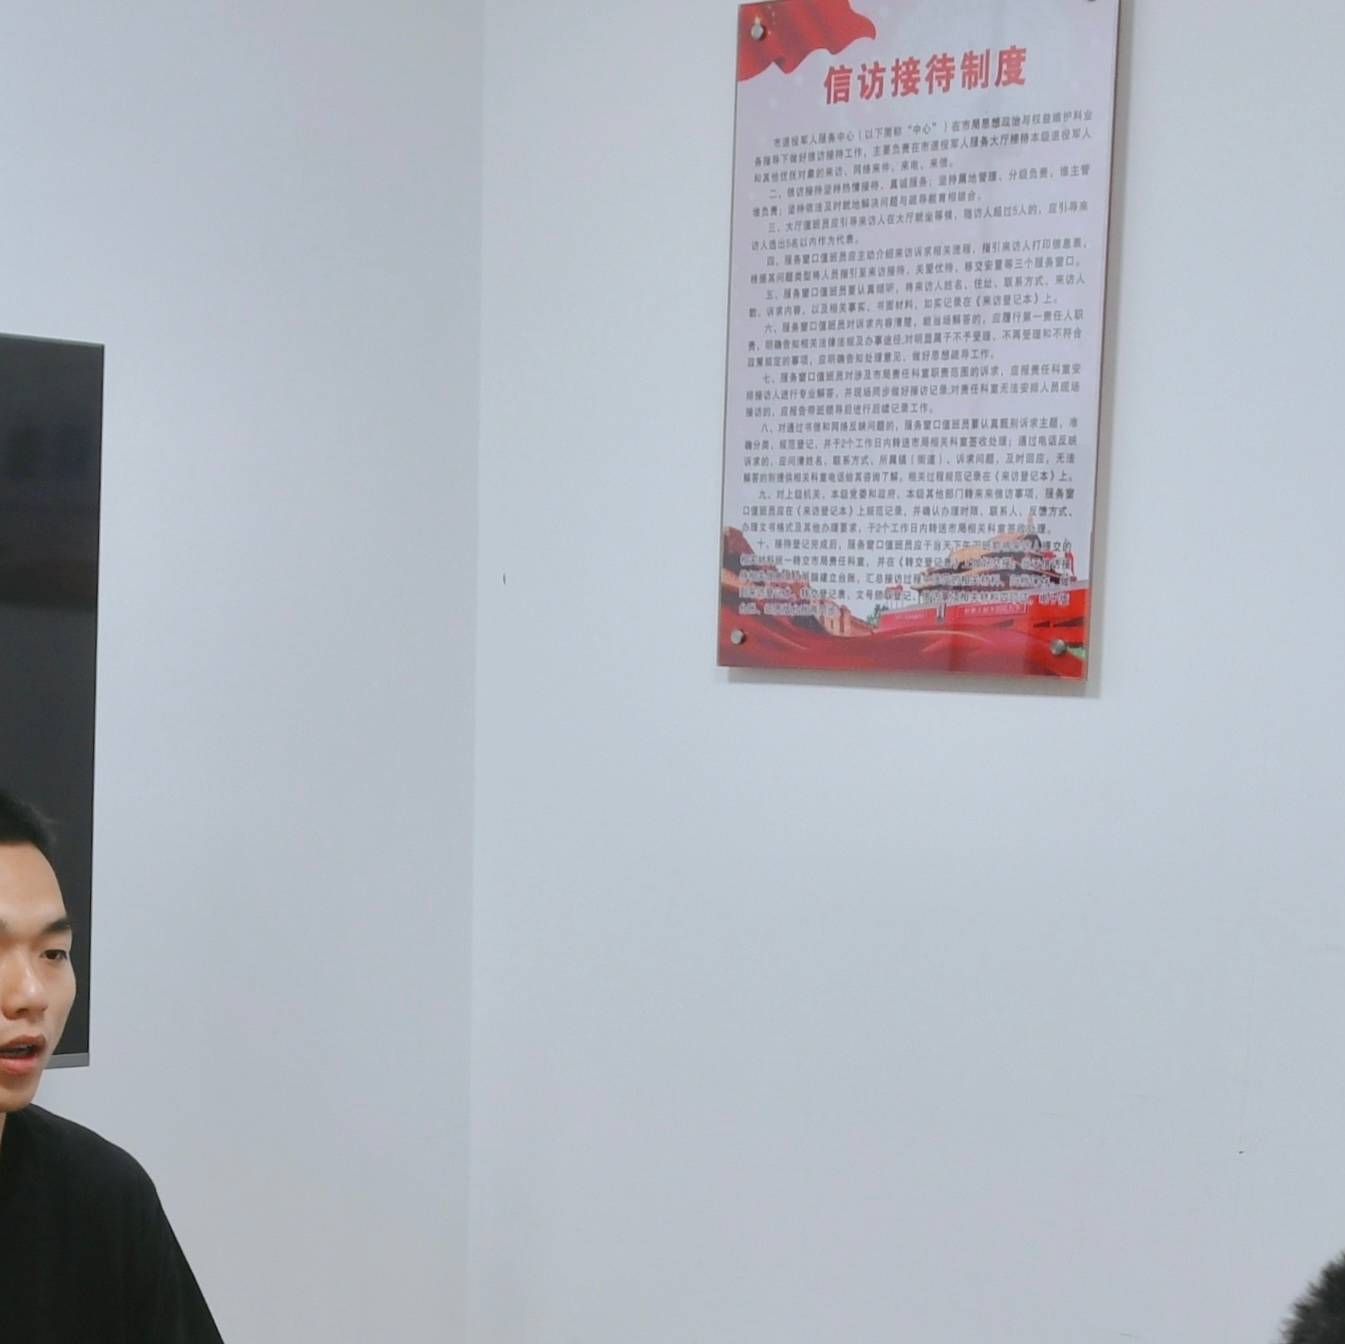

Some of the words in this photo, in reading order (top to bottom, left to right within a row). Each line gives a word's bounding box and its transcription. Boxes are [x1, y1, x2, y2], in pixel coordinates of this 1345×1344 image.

[824, 45, 1027, 104] 信访接待制度
